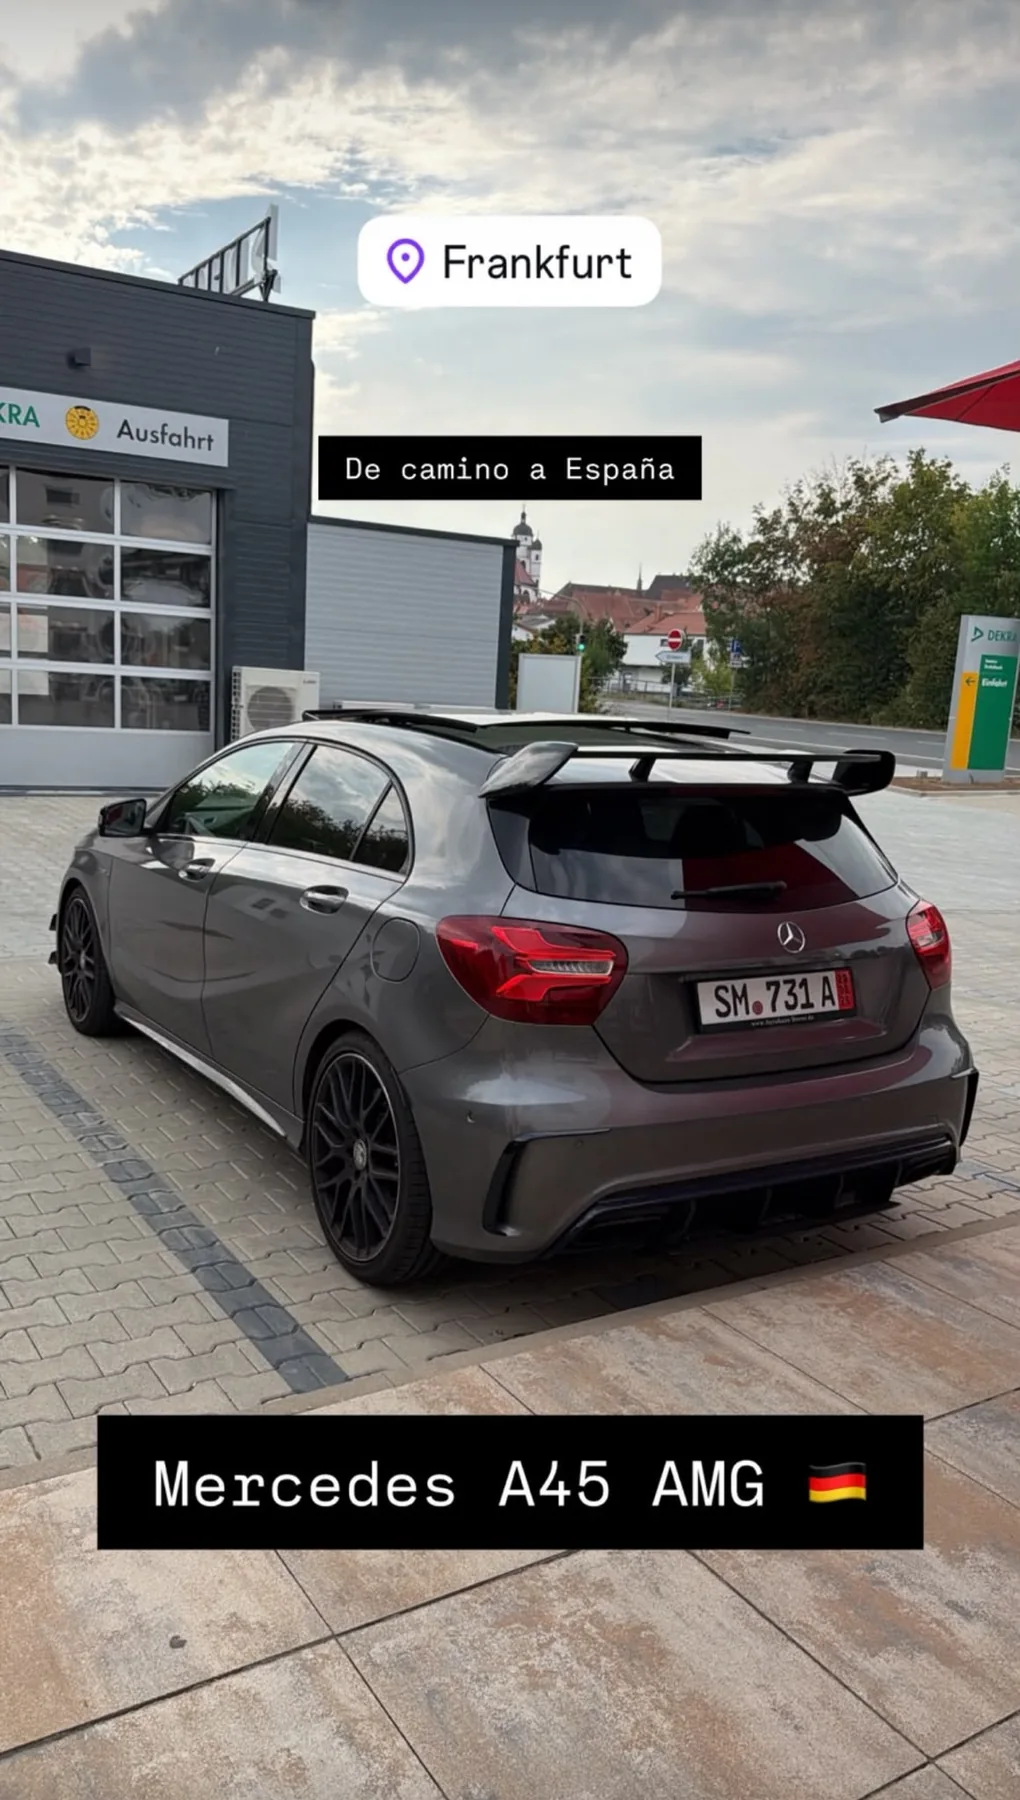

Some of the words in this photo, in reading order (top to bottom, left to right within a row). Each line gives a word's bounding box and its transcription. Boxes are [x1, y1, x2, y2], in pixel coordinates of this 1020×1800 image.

[116, 418, 215, 452] Ausfahrt
[714, 983, 750, 1018] SM
[766, 978, 814, 1012] 731
[821, 976, 836, 1007] A
